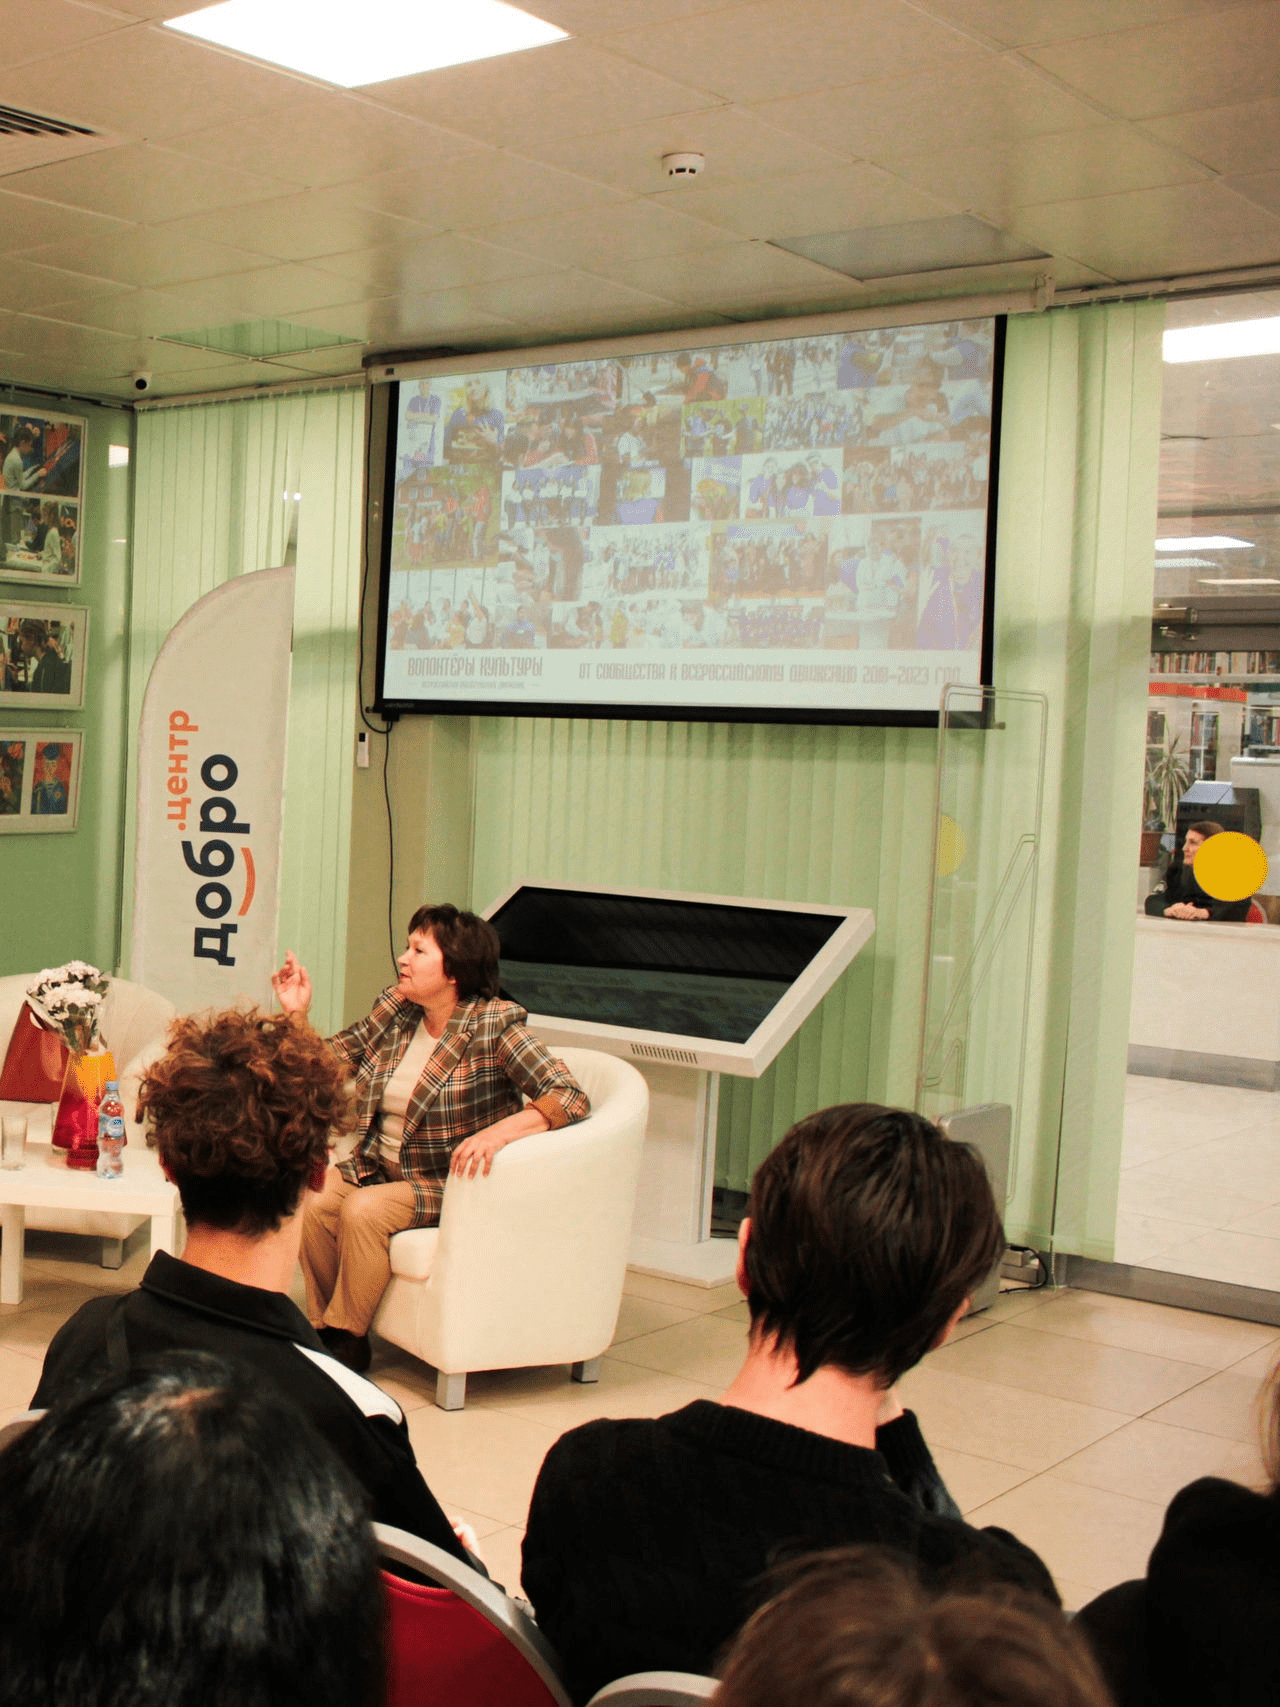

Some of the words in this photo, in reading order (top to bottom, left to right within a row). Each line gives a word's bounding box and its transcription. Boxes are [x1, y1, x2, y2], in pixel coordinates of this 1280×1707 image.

[408, 653, 475, 677] ВОЛОНТЁРЫ
[480, 656, 544, 677] КУЛЬТУРЫ
[578, 662, 593, 680] ОТ
[596, 662, 666, 680] СООБЩЕСТВА
[669, 662, 678, 680] К
[681, 661, 785, 682] ВСЕРОССИЙСКОМУ
[789, 663, 858, 683] ДВИЖЕНИЮ
[181, 753, 251, 966] добро
